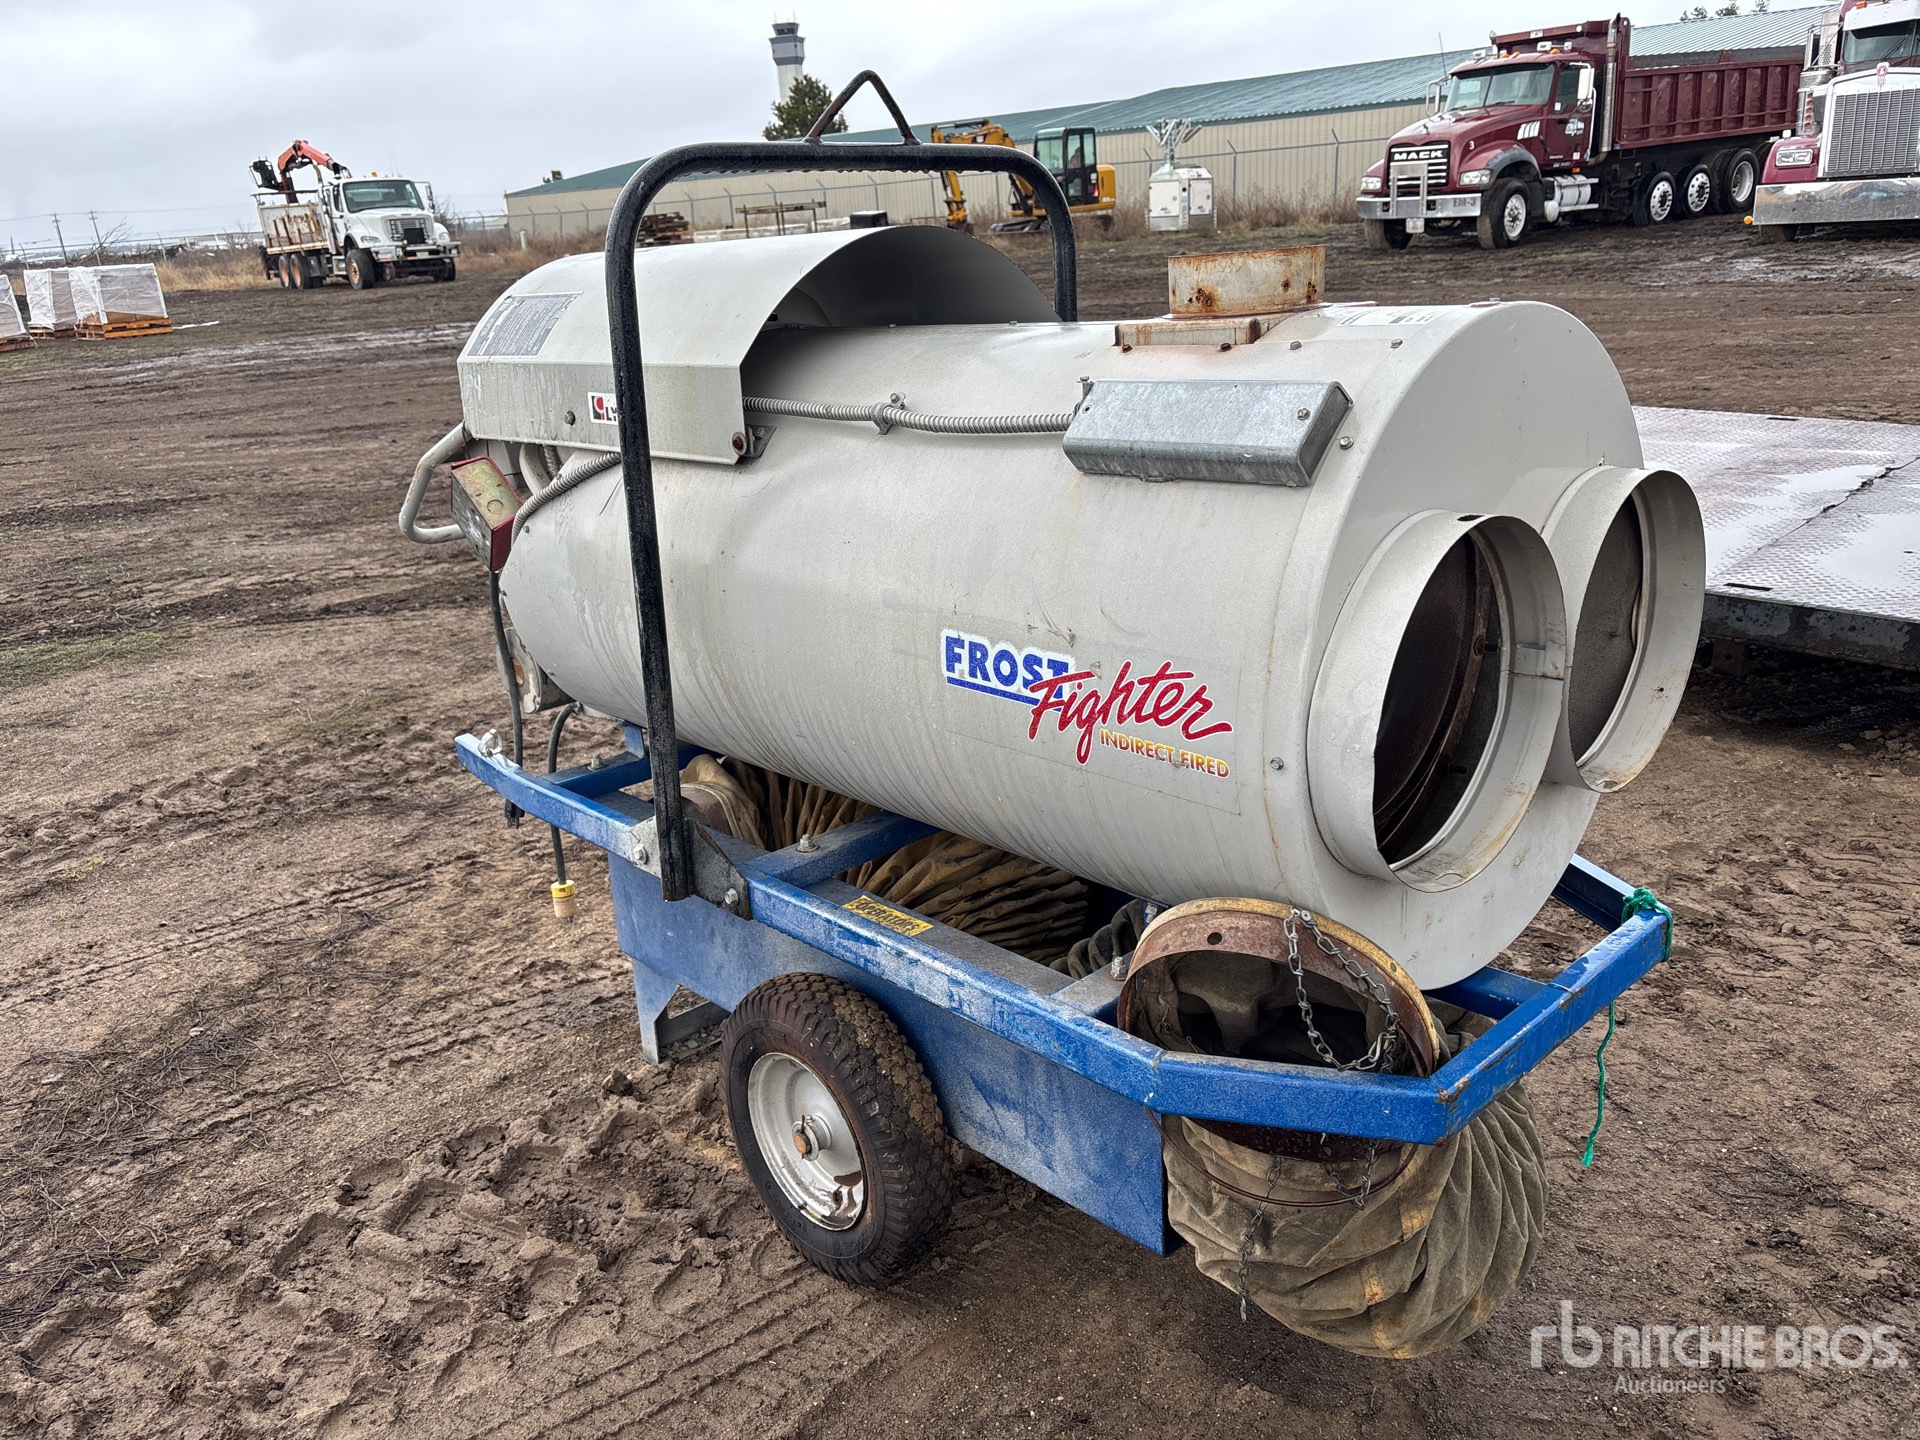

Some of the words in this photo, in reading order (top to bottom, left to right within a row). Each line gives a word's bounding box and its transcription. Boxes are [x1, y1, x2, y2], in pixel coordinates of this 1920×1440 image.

[1394, 150, 1443, 160] MACK
[944, 634, 1070, 698] FROST
[1028, 661, 1233, 765] Fighter
[1099, 729, 1174, 763] INDIRECT
[1180, 748, 1230, 778] FIRED
